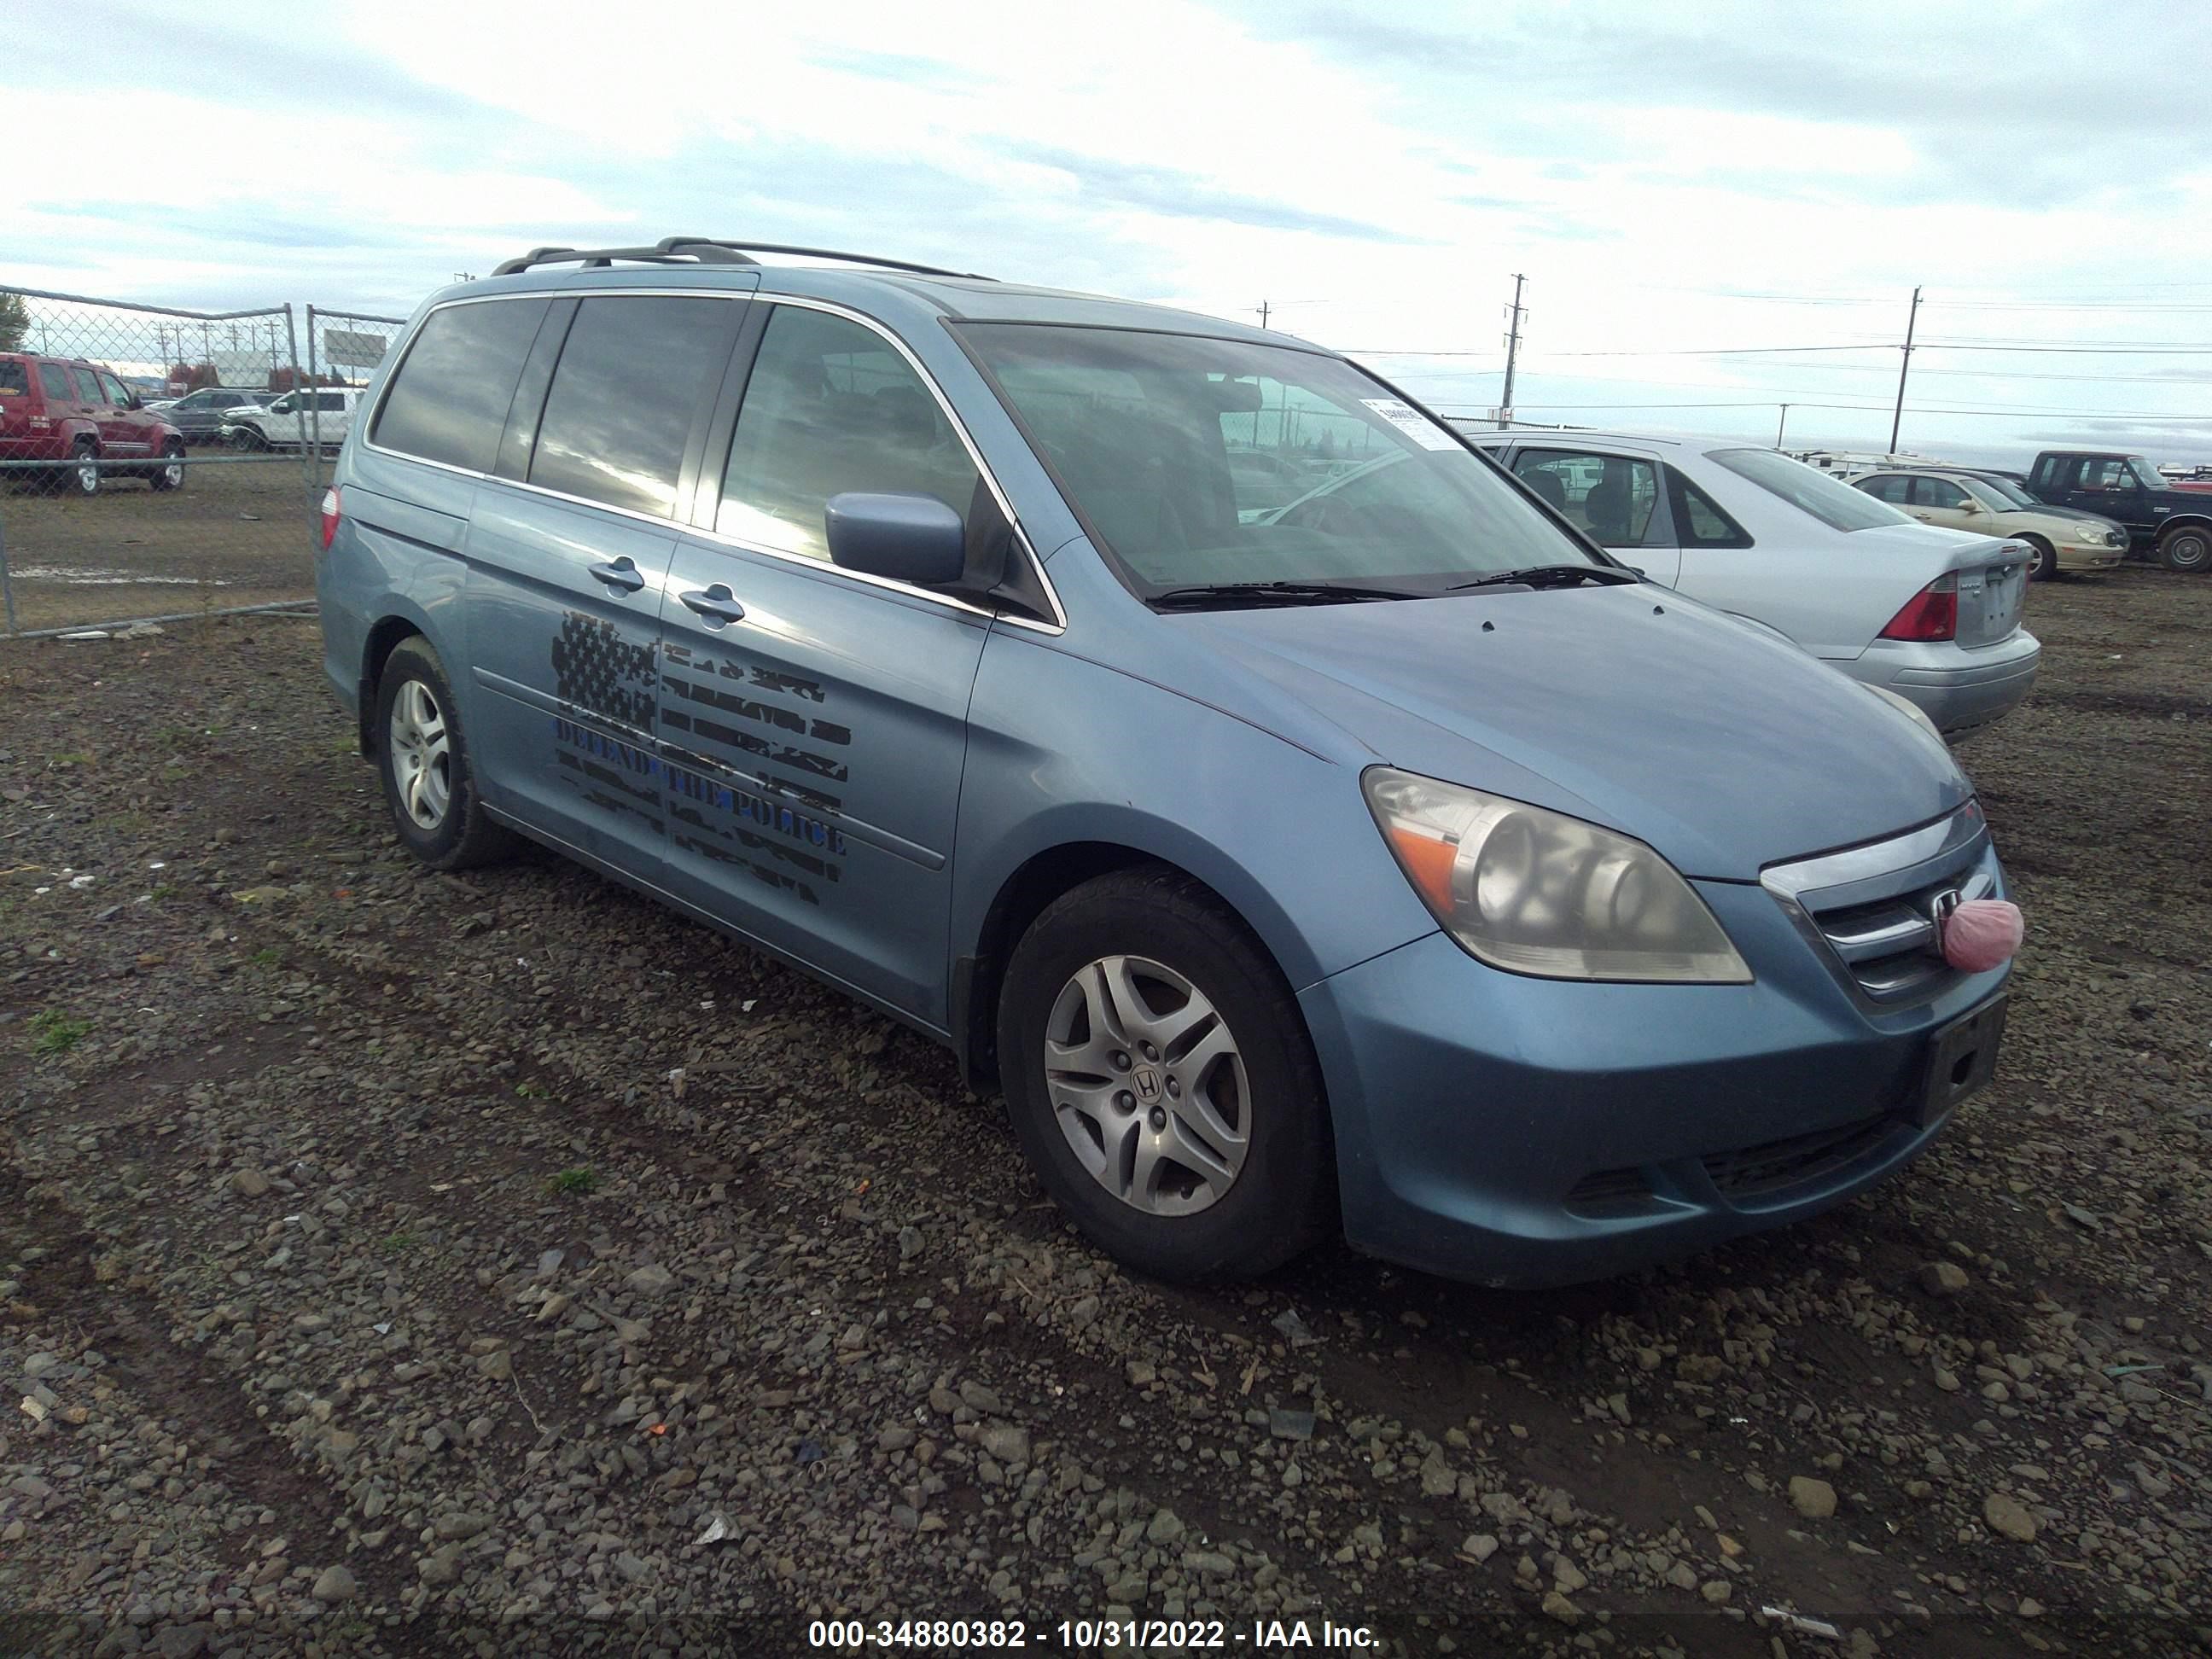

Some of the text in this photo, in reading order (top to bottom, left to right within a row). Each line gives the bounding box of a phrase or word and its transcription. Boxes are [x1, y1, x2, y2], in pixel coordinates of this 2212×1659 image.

[555, 717, 848, 856] DEFEND THE POLICE
